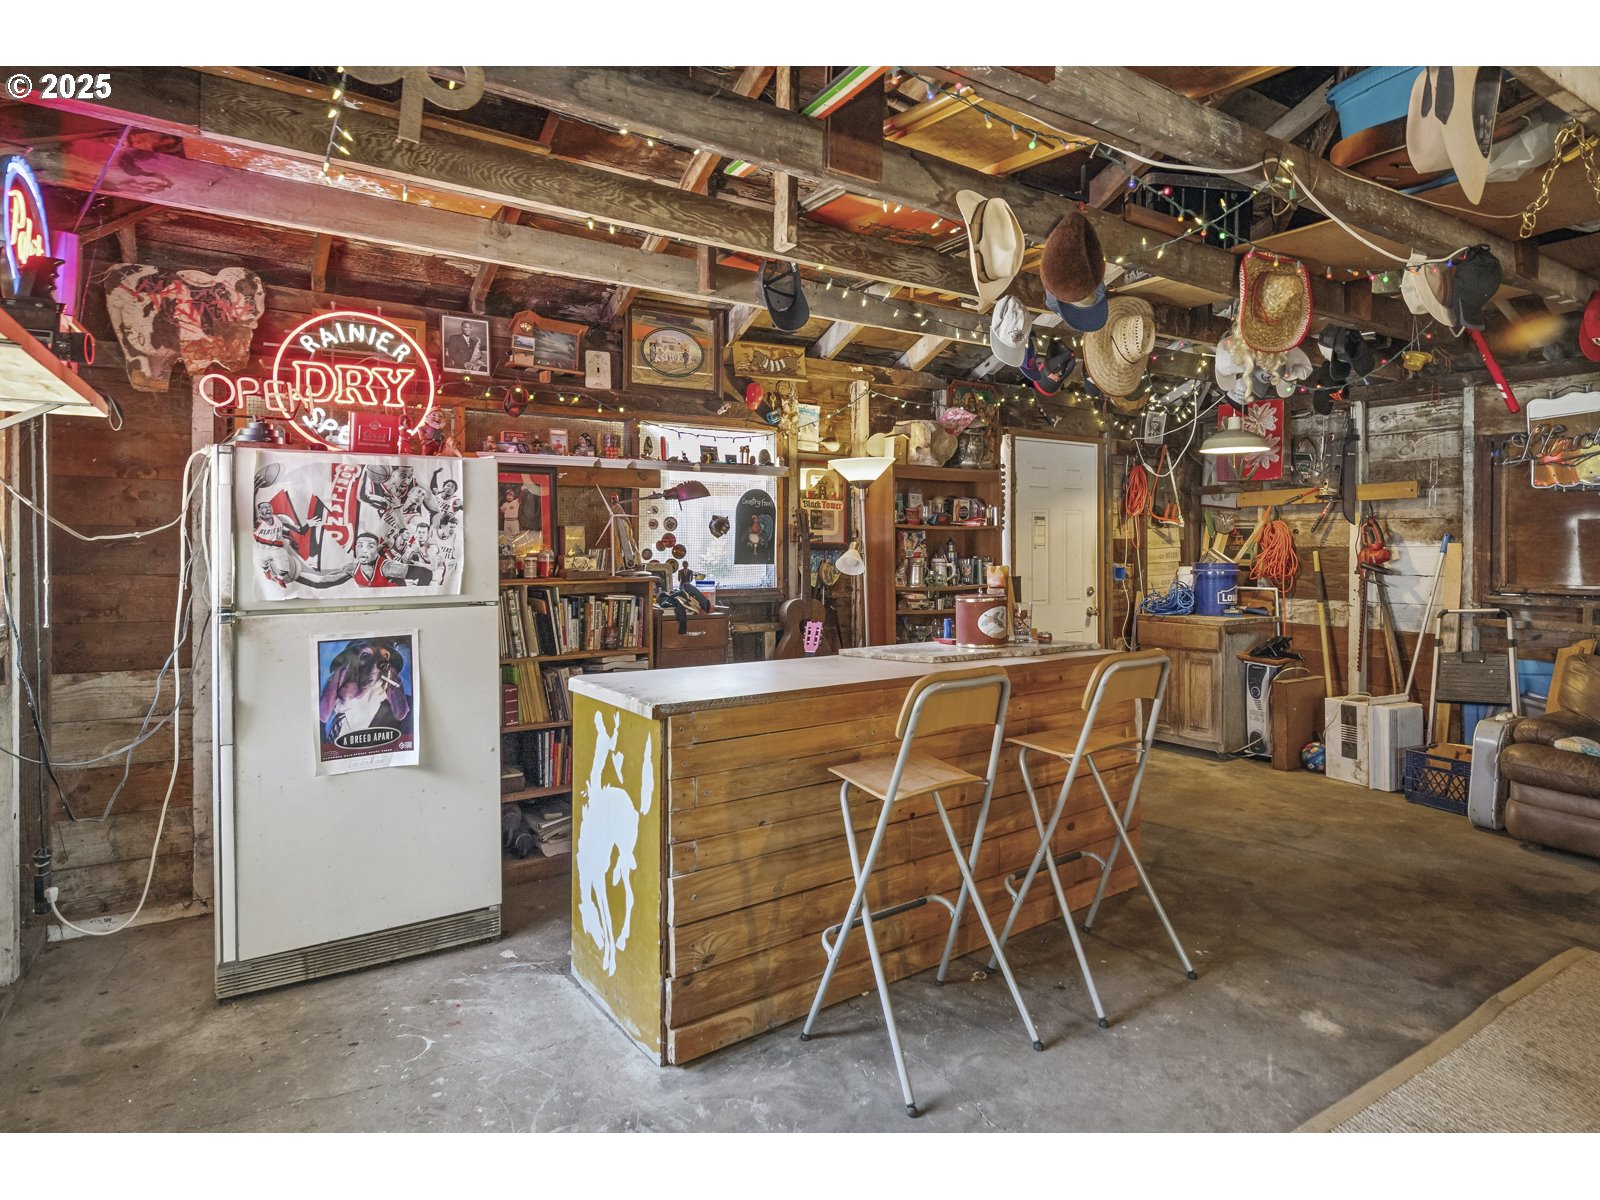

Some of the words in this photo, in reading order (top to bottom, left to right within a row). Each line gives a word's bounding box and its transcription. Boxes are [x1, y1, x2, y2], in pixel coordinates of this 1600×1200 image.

[300, 322, 412, 363] RAINIER
[199, 373, 314, 415] OPEN
[292, 360, 417, 408] DRY
[802, 500, 821, 509] Black
[821, 500, 842, 510] Tower
[343, 736, 348, 746] A
[349, 733, 372, 744] BREED
[373, 731, 394, 742] APART
